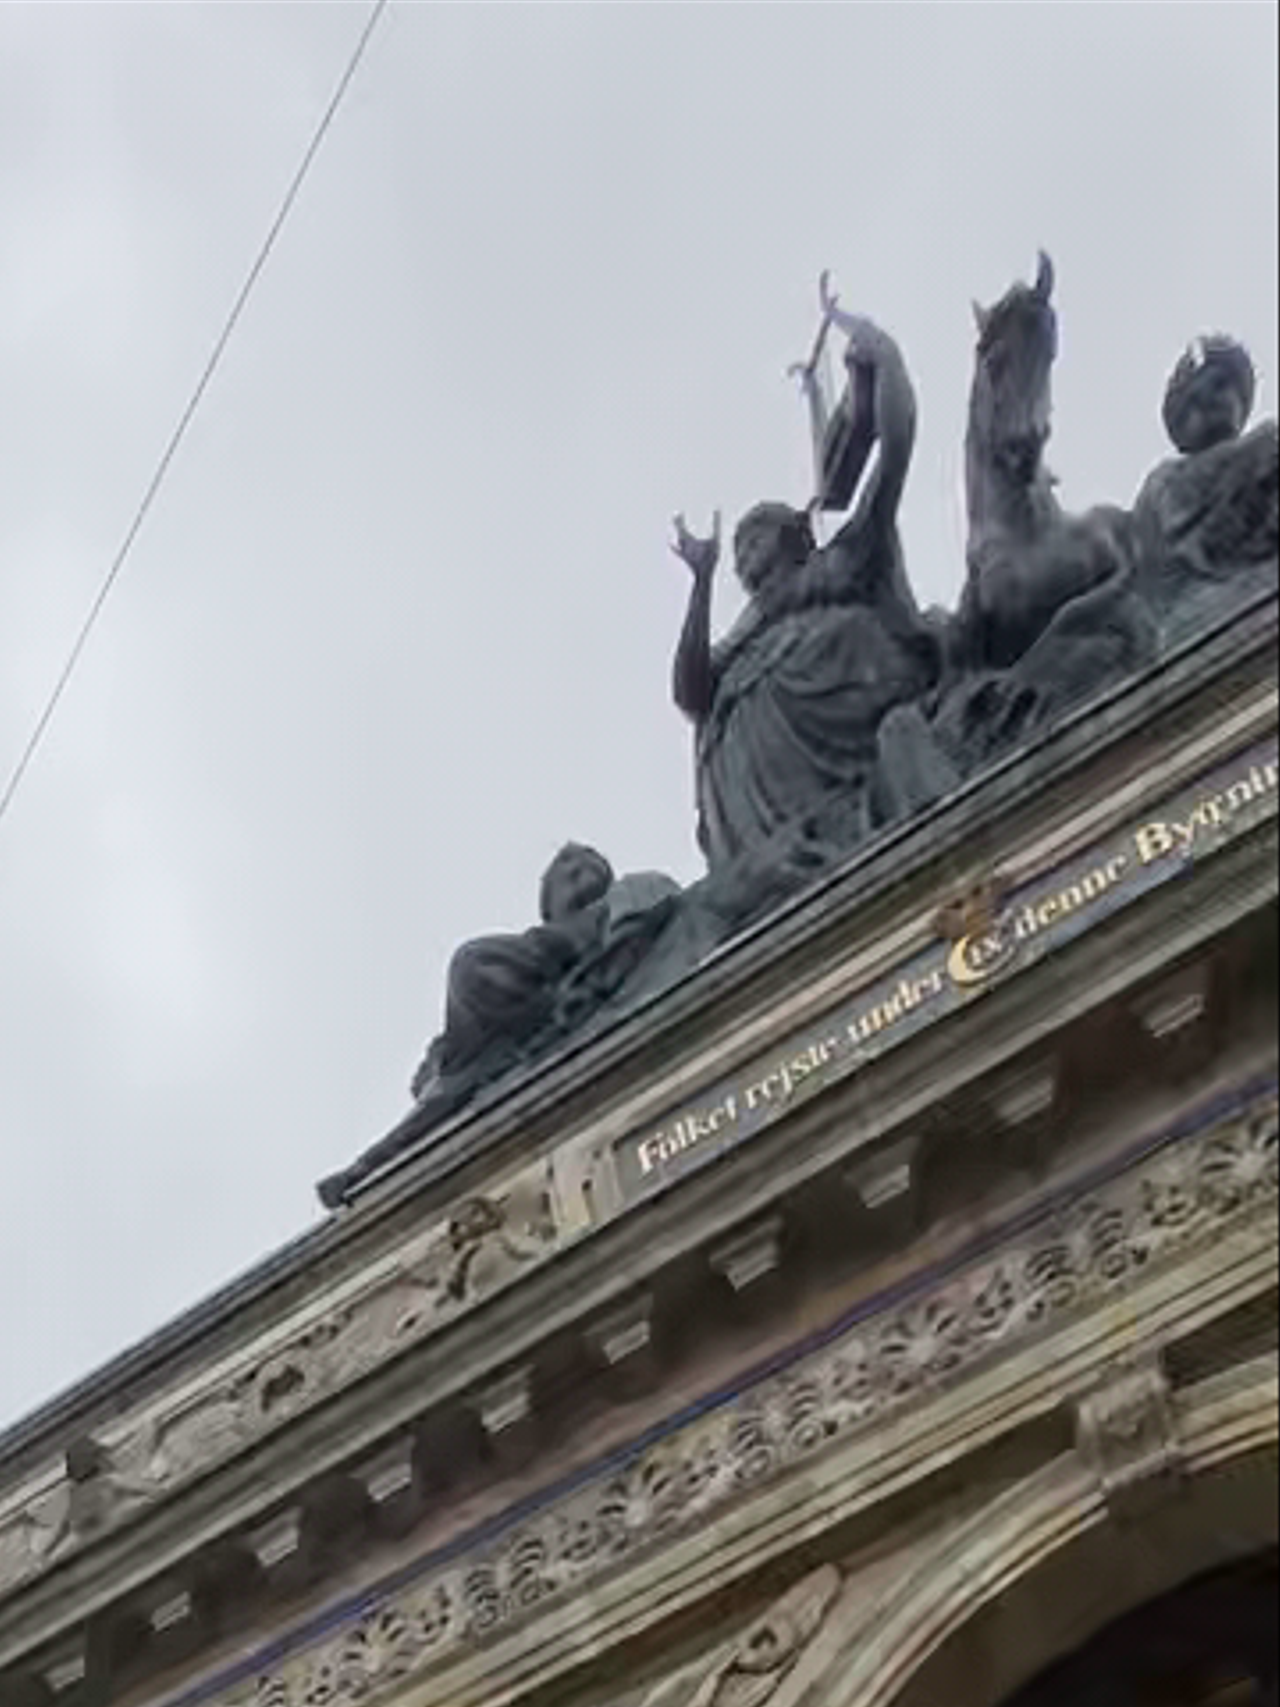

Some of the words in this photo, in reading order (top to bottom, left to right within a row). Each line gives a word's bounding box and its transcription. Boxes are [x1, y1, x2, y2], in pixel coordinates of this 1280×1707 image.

[638, 1094, 737, 1175] Folket
[846, 970, 941, 1043] under
[1014, 854, 1128, 938] denne
